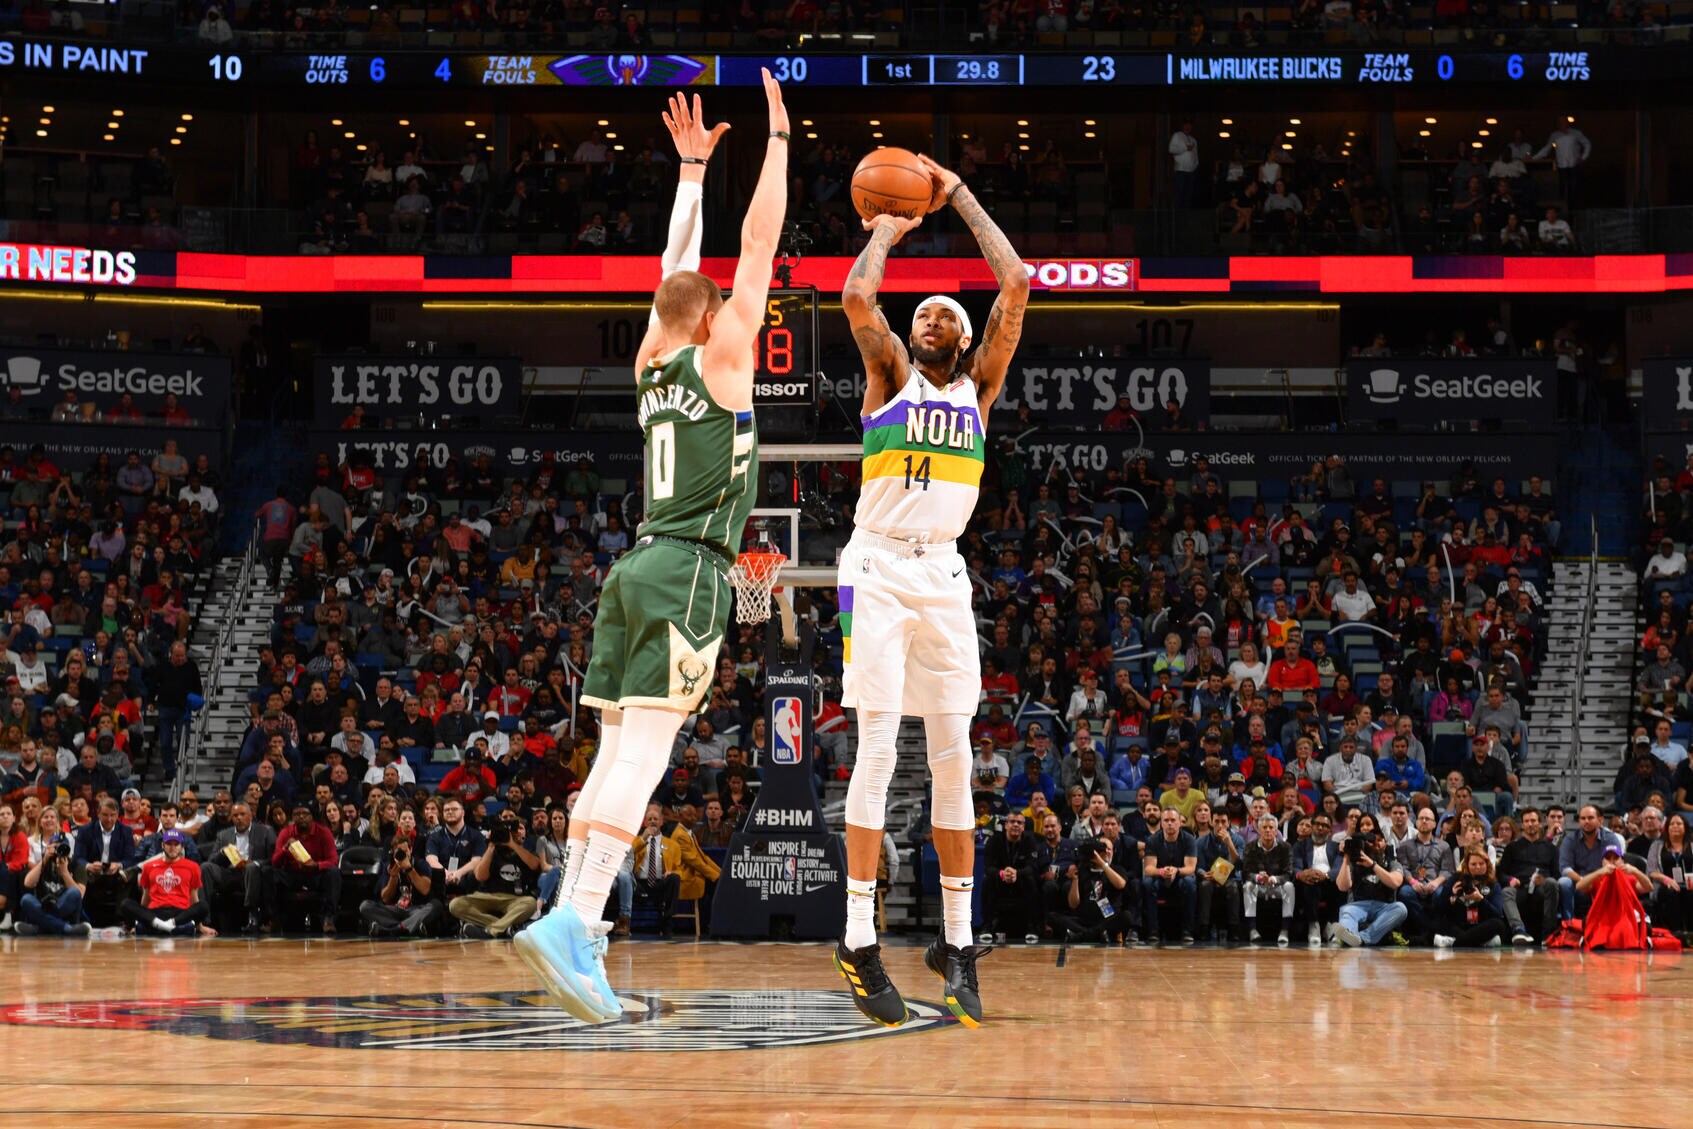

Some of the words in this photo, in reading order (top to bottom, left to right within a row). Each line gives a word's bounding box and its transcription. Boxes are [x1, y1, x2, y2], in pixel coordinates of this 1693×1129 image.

[24, 43, 53, 69] IN
[63, 45, 148, 74] PAINT
[208, 54, 242, 81] 10
[308, 55, 347, 70] TIME
[487, 55, 532, 70] TEAM
[1363, 53, 1409, 68] TEAM
[1437, 55, 1454, 80] 0
[1506, 54, 1524, 79] 6
[1548, 51, 1588, 67] TIME
[305, 69, 349, 84] OUTS
[369, 57, 386, 82] 6
[434, 57, 452, 82] 4
[482, 69, 537, 84] FOULS
[774, 57, 808, 82] 30
[885, 61, 912, 78] 1st
[956, 60, 1000, 80] 29.8
[1082, 56, 1116, 81] 23
[1180, 57, 1279, 81] MILWAUKEE
[1282, 57, 1342, 80] BUCKS
[1358, 68, 1414, 83] FOULS
[1545, 66, 1591, 82] OUTS
[28, 247, 137, 286] NEEDS
[58, 363, 204, 398] SeatGeek
[331, 362, 440, 405] LET'S
[448, 365, 504, 406] GO
[1126, 366, 1189, 411] GO
[1413, 372, 1544, 400] SeatGeek
[905, 406, 975, 451] NOLA
[651, 421, 676, 500] 0
[1191, 451, 1256, 465] SatGeek
[1268, 454, 1304, 463] OFFICIAL
[1349, 454, 1384, 464] PARTNER
[1385, 454, 1396, 464] OF
[1399, 454, 1413, 464] THE
[1415, 454, 1435, 464] NEW
[1473, 454, 1512, 464] PELICANS
[904, 455, 931, 491] 14
[767, 674, 809, 686] SPALDING
[776, 747, 791, 761] NBA
[755, 809, 813, 827] #BHM
[768, 841, 800, 856] INSPIRE
[731, 862, 783, 880] EQUALITY
[797, 858, 819, 868] HISTORY
[804, 870, 838, 882] ACTIVATE
[770, 881, 795, 895] LOVE
